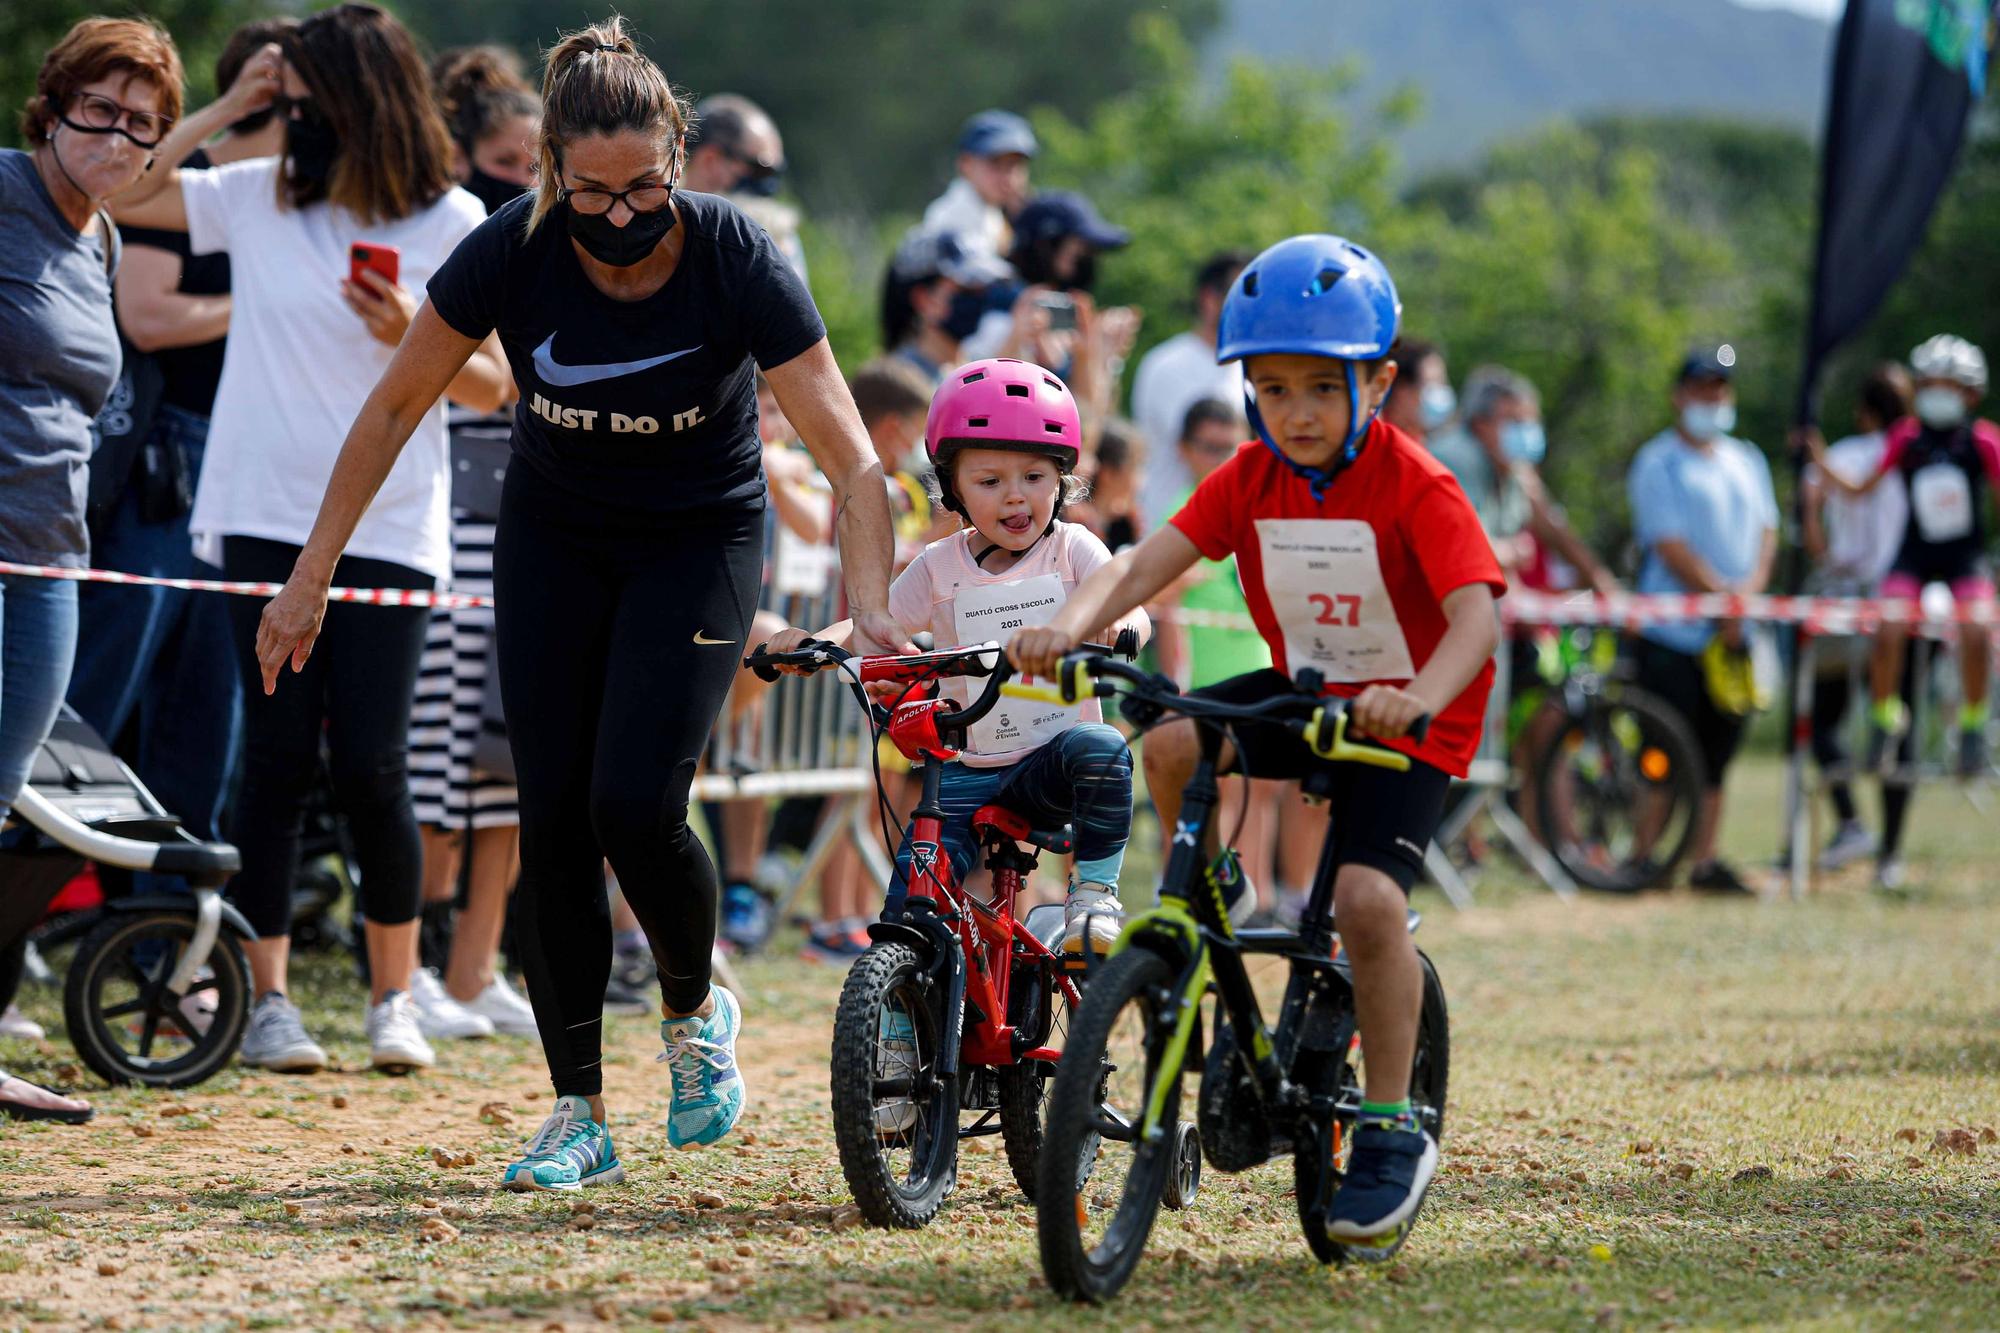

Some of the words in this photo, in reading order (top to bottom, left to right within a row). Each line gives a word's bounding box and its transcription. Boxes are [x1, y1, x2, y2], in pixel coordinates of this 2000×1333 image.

[530, 392, 598, 431] JUST
[611, 412, 659, 434] DO
[673, 406, 706, 432] IT.
[965, 606, 993, 618] DUATLÓ
[994, 604, 1019, 614] CROSS
[1020, 597, 1056, 609] ESCOLAR
[1308, 593, 1362, 627] 27
[1000, 619, 1023, 629] 2021
[897, 702, 933, 724] APOLON
